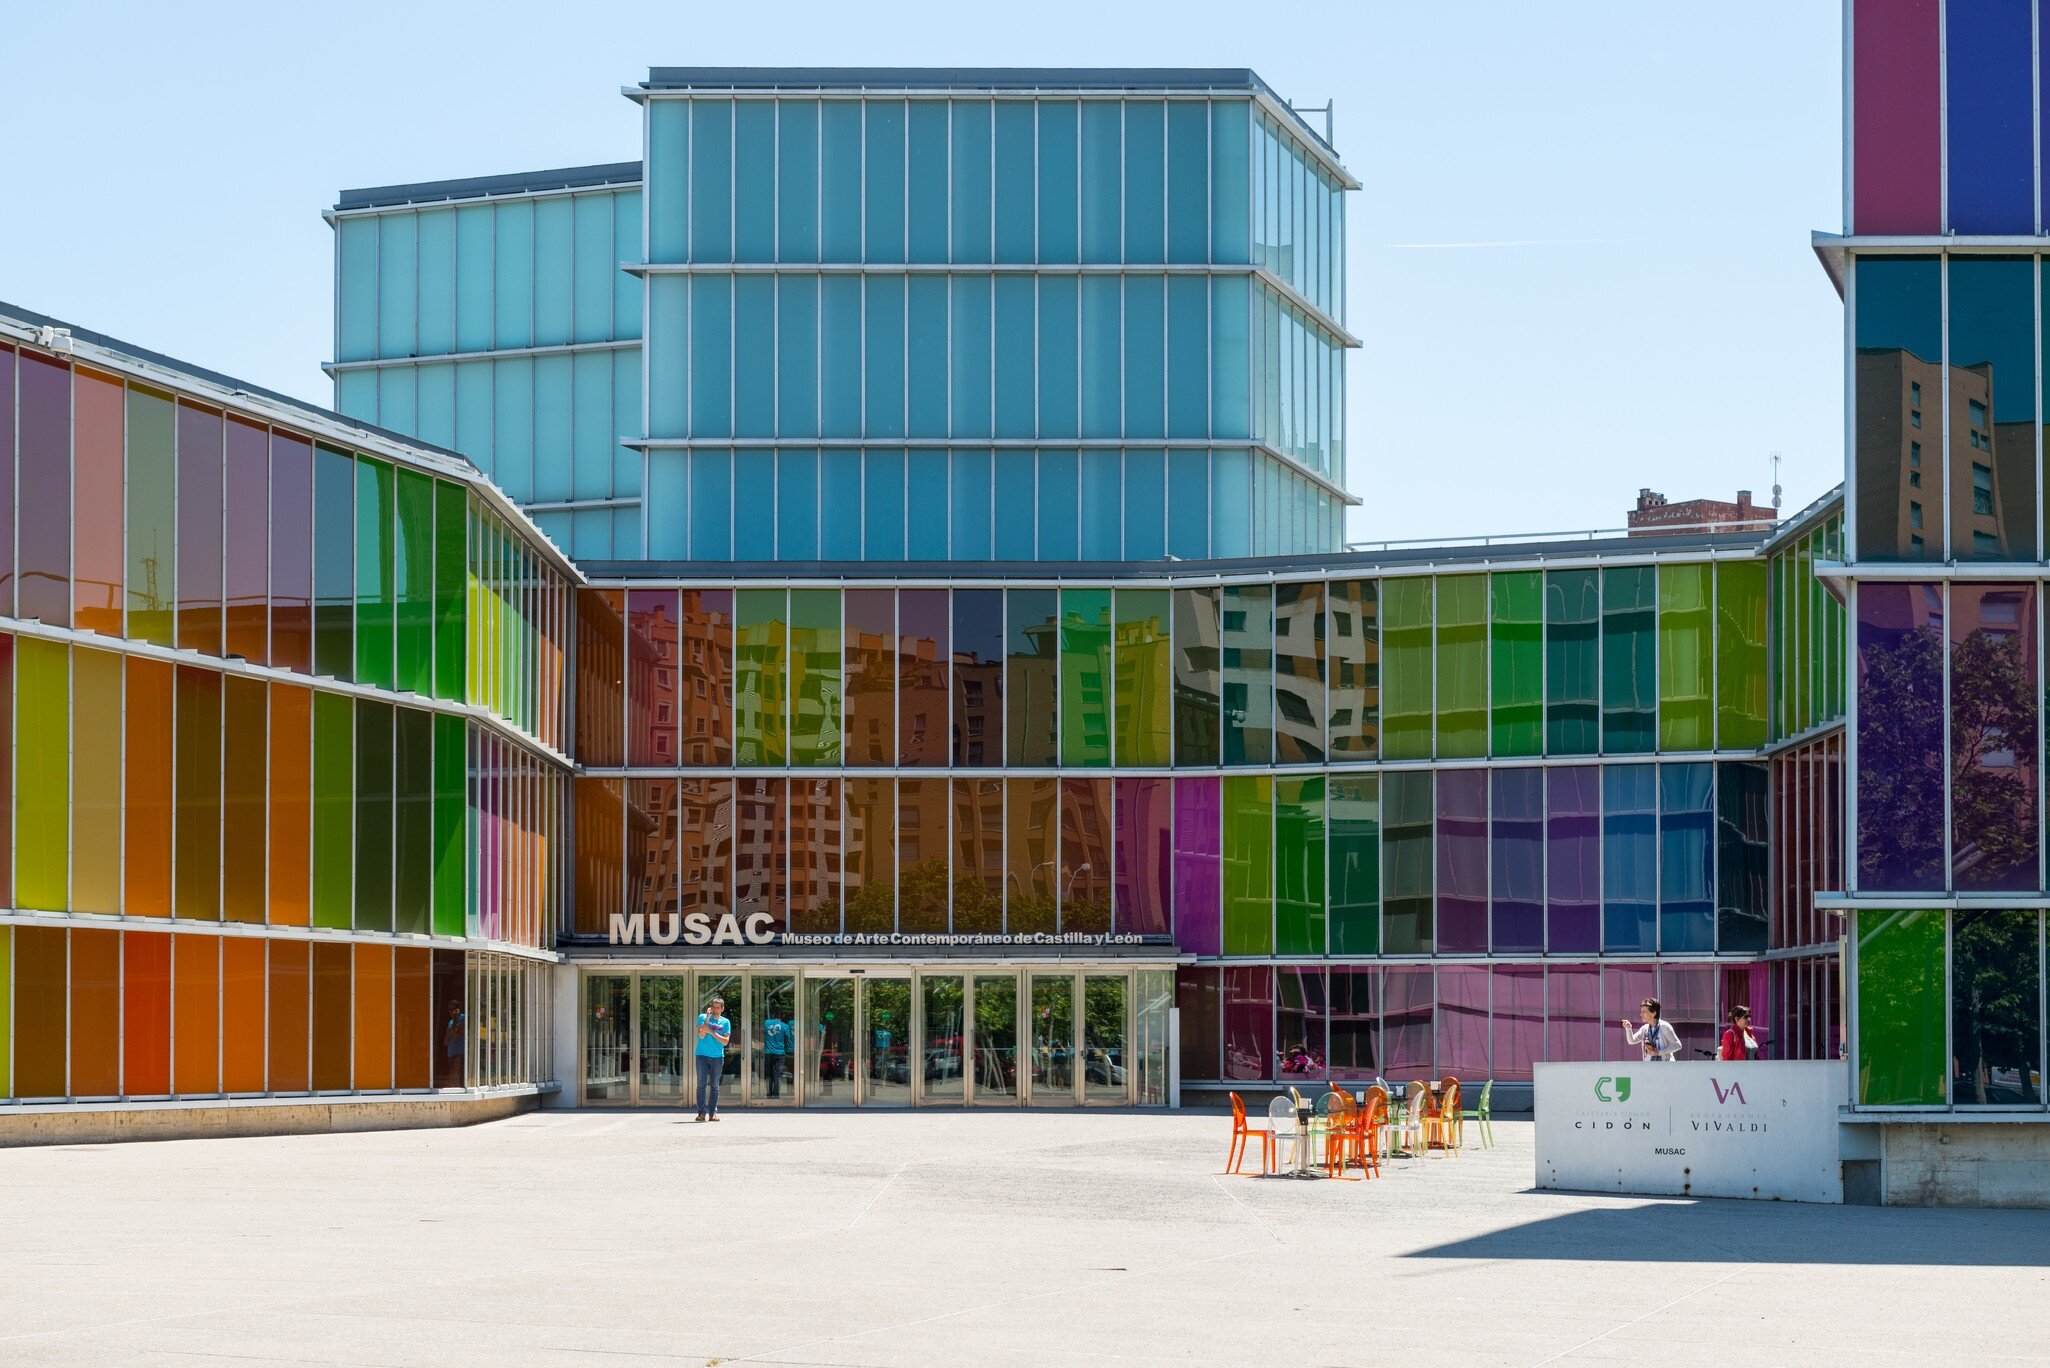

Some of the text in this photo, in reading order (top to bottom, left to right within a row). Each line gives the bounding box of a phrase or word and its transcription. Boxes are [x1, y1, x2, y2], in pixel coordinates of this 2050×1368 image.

[609, 912, 1143, 946] MUSAC Museo de Arte Contemporáneo de Castilla y León
